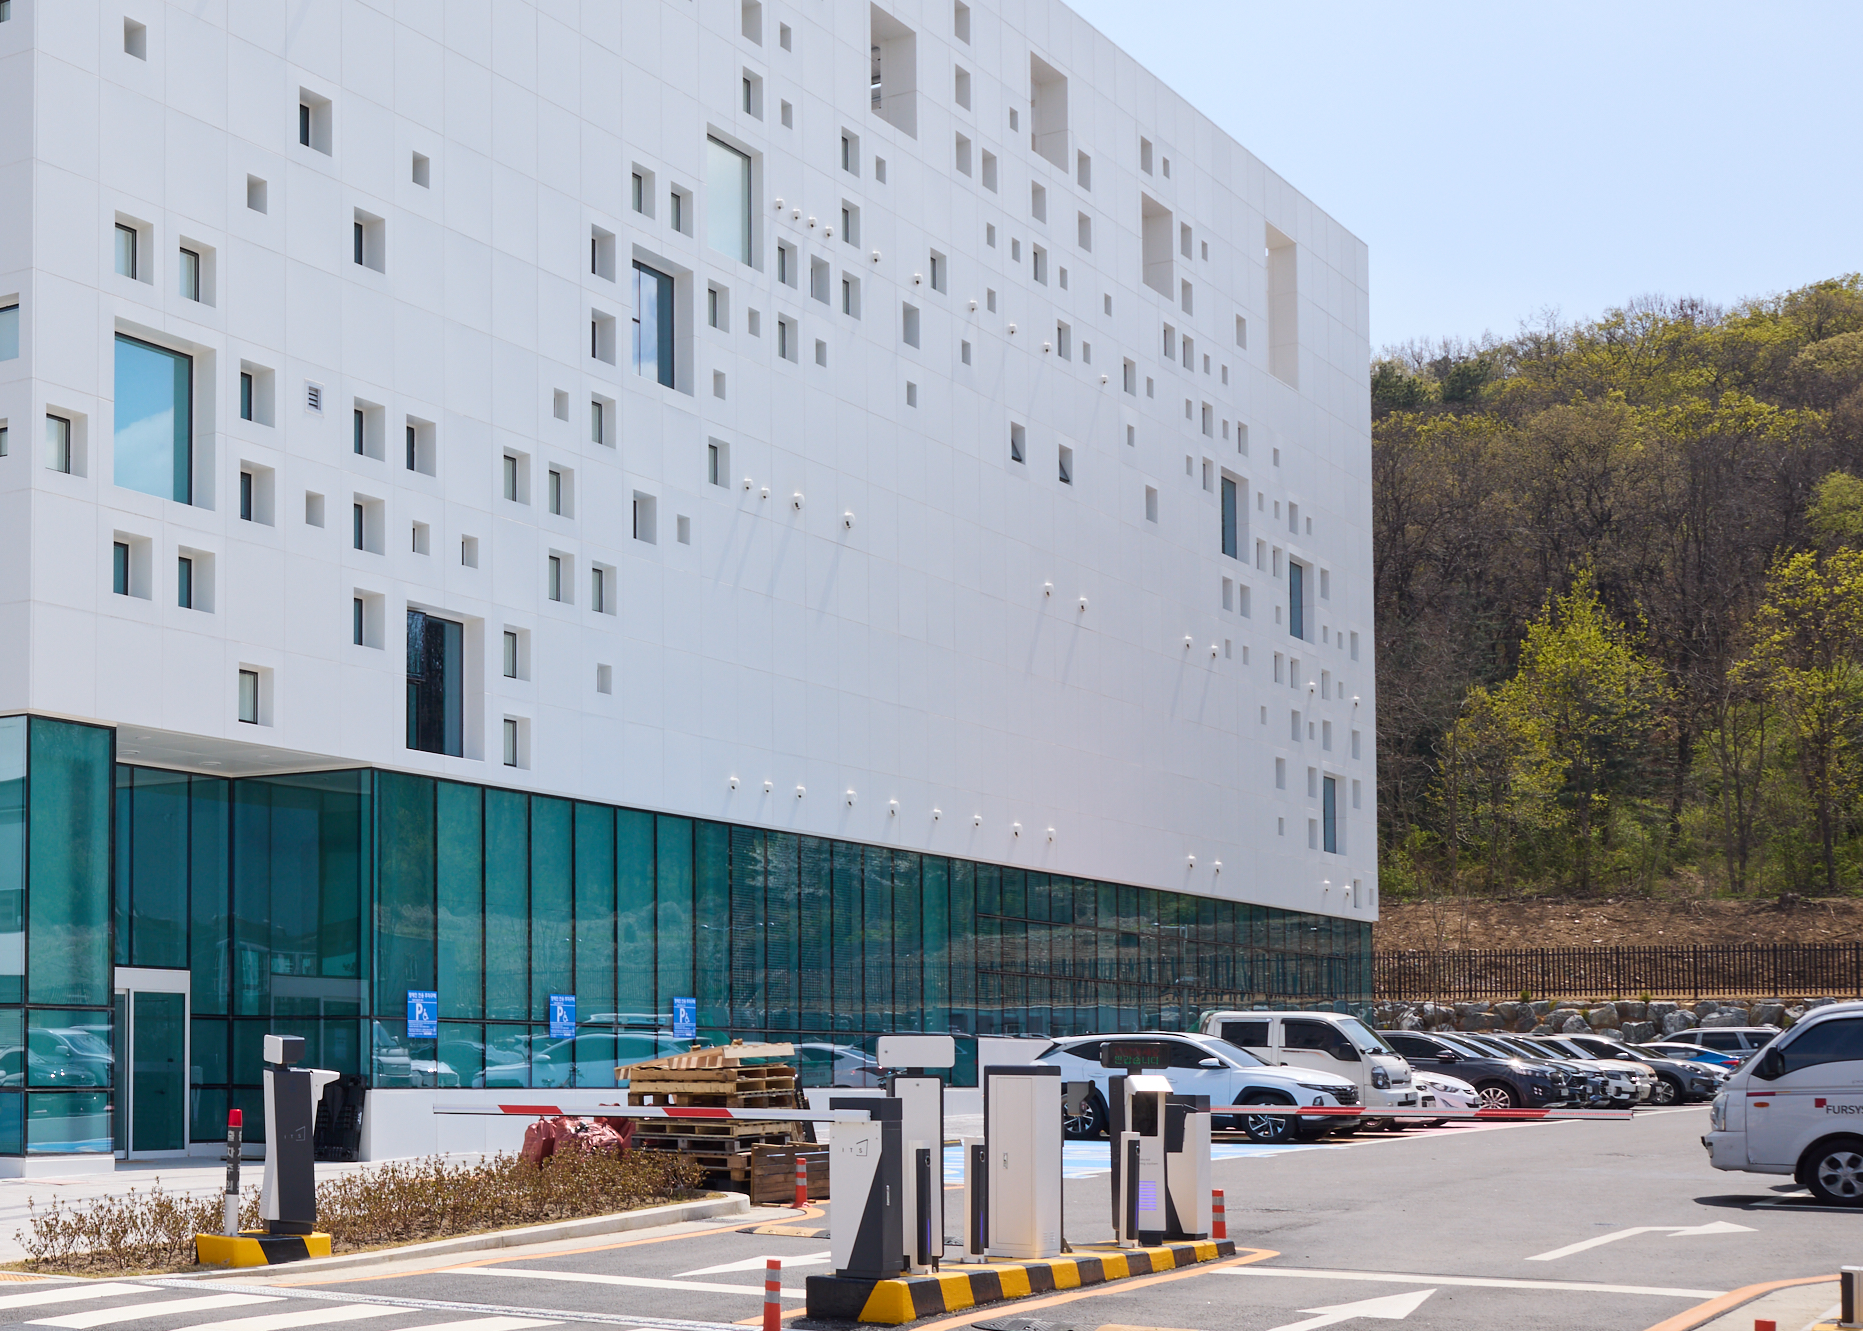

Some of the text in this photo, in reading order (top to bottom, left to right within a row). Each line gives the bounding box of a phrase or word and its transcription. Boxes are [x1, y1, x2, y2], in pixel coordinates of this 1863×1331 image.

[416, 1003, 423, 1021] P
[557, 1006, 564, 1023] P
[679, 1008, 686, 1023] P
